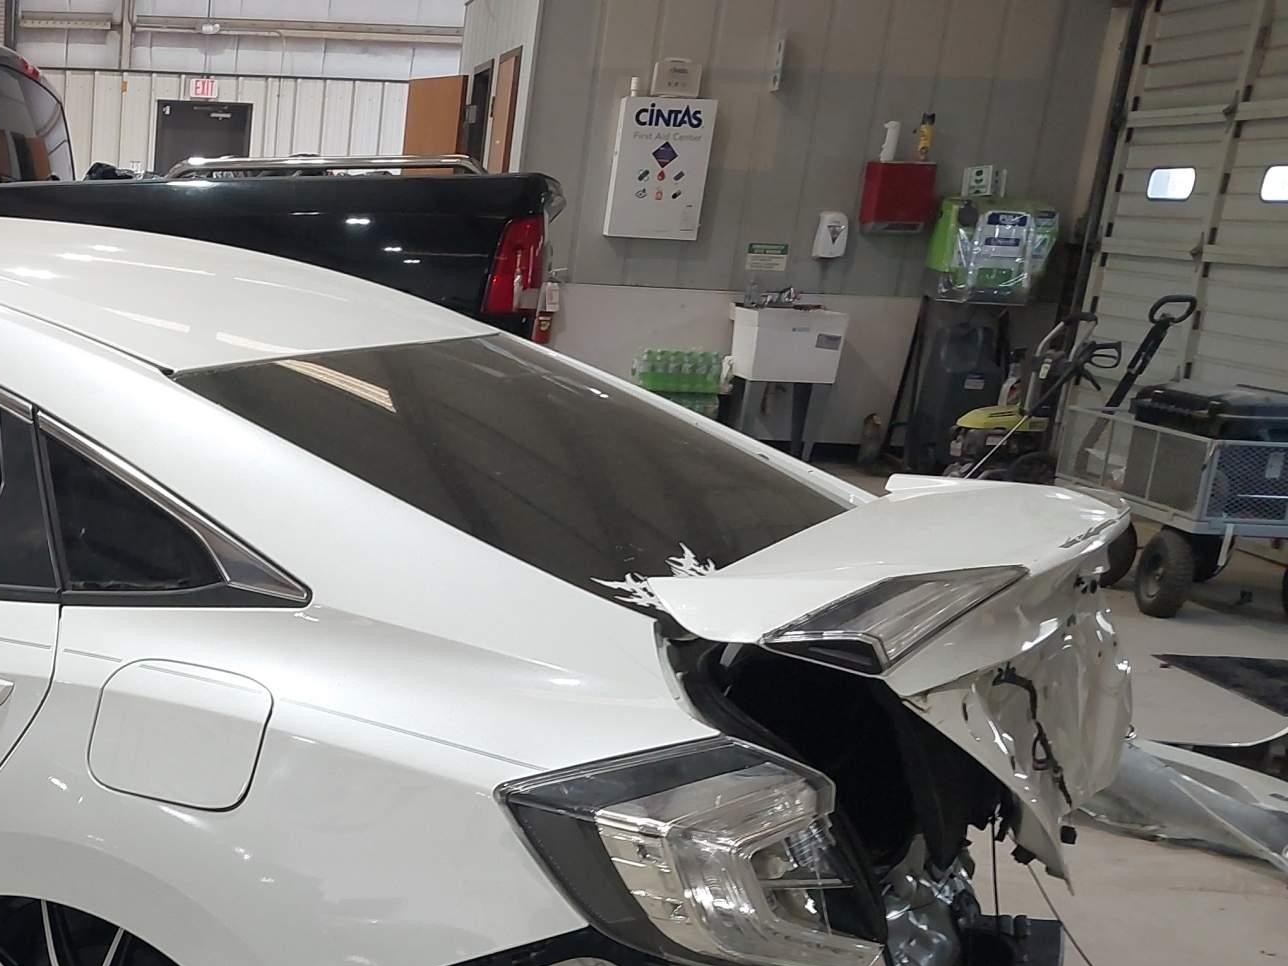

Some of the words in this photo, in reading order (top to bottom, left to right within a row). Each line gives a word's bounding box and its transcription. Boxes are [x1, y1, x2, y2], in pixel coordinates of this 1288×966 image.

[195, 80, 215, 96] EXIT
[635, 102, 703, 129] CINTAS
[633, 131, 653, 140] First
[655, 131, 671, 140] Aid
[673, 132, 702, 141] Center
